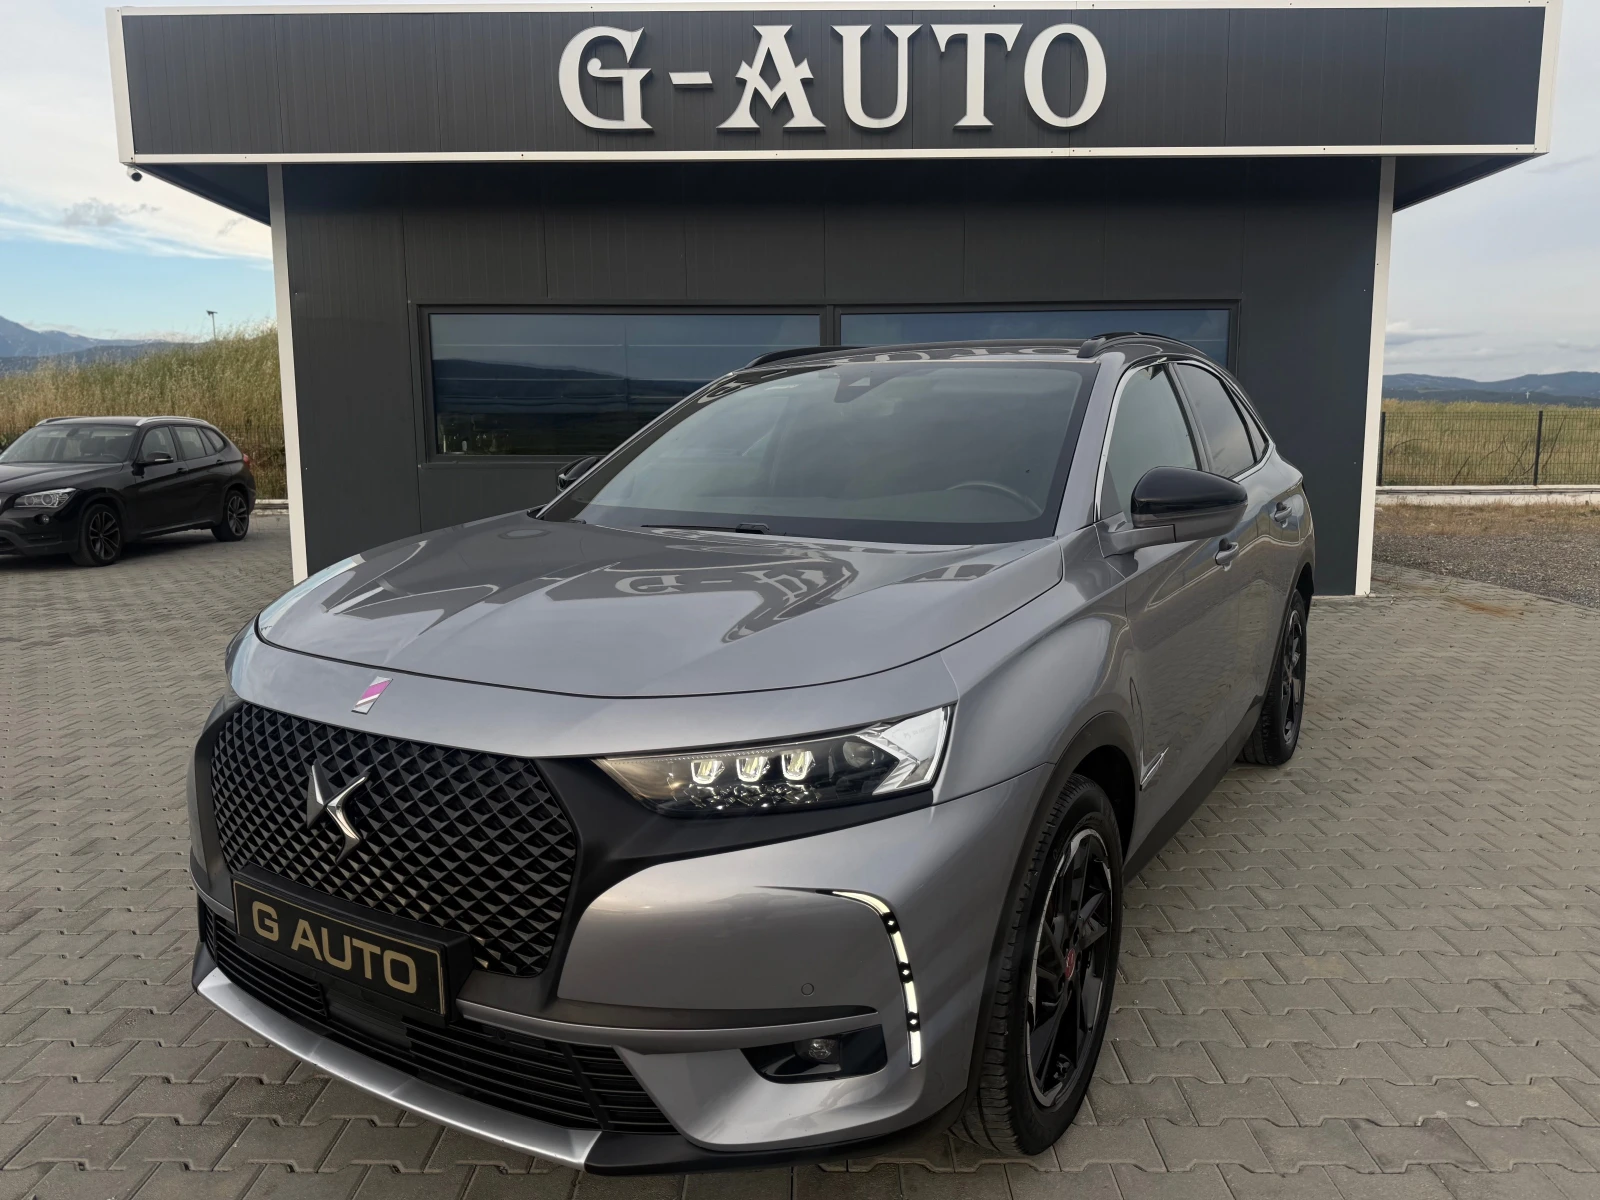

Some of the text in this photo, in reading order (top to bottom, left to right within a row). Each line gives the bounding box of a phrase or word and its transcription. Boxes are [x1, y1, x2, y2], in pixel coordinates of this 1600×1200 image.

[558, 23, 1107, 131] G-AUTO
[251, 900, 418, 994] G AUTO
